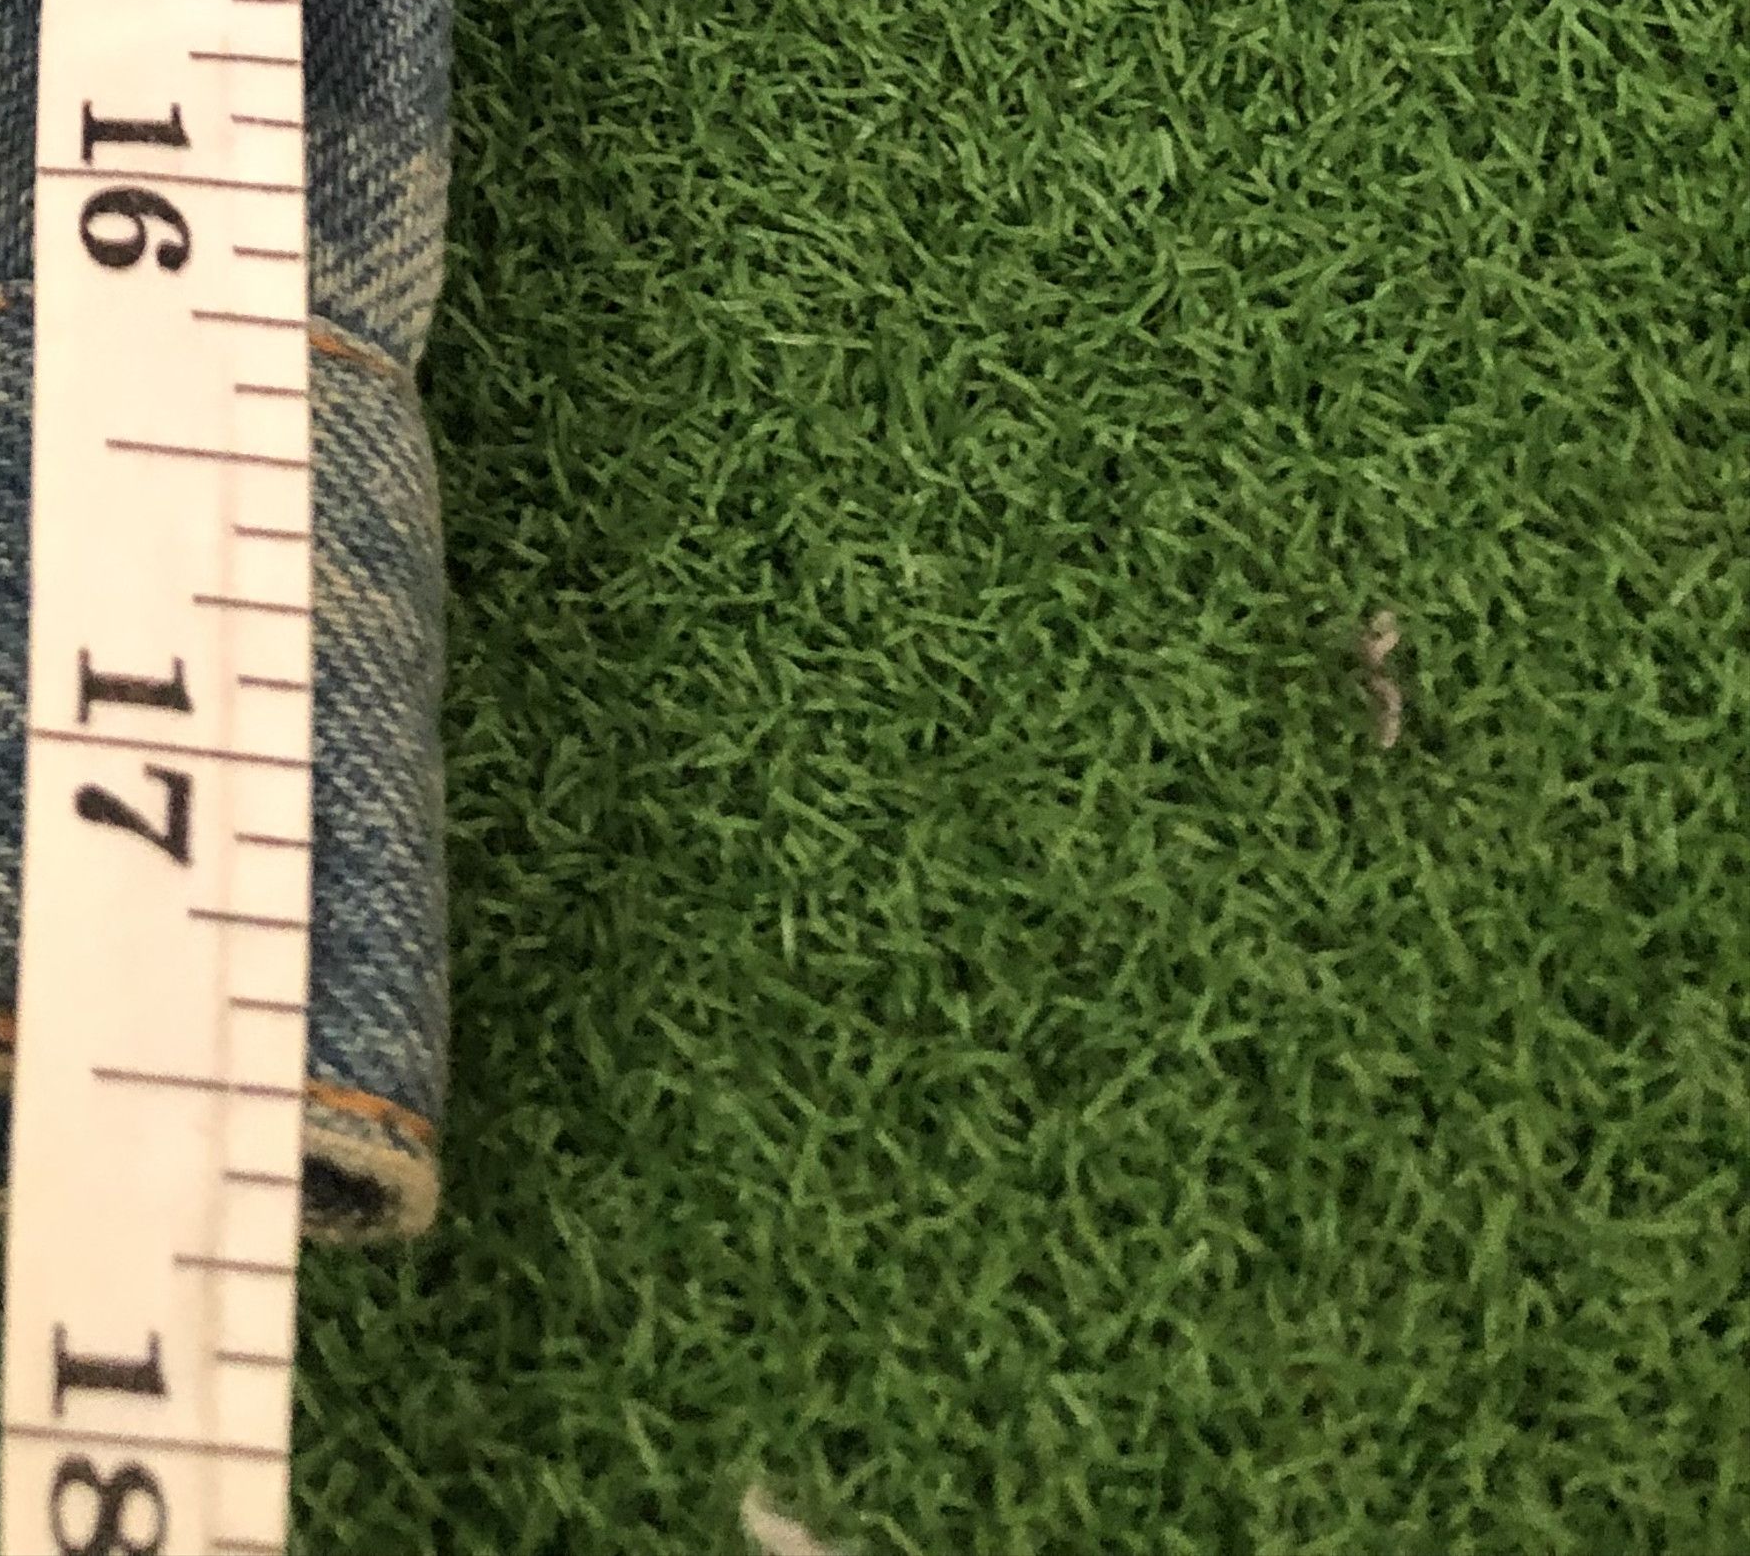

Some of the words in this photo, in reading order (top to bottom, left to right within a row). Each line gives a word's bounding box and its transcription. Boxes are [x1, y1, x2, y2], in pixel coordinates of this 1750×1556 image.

[77, 98, 193, 275] 16
[73, 644, 195, 869] 17
[48, 1321, 169, 1556] 18
